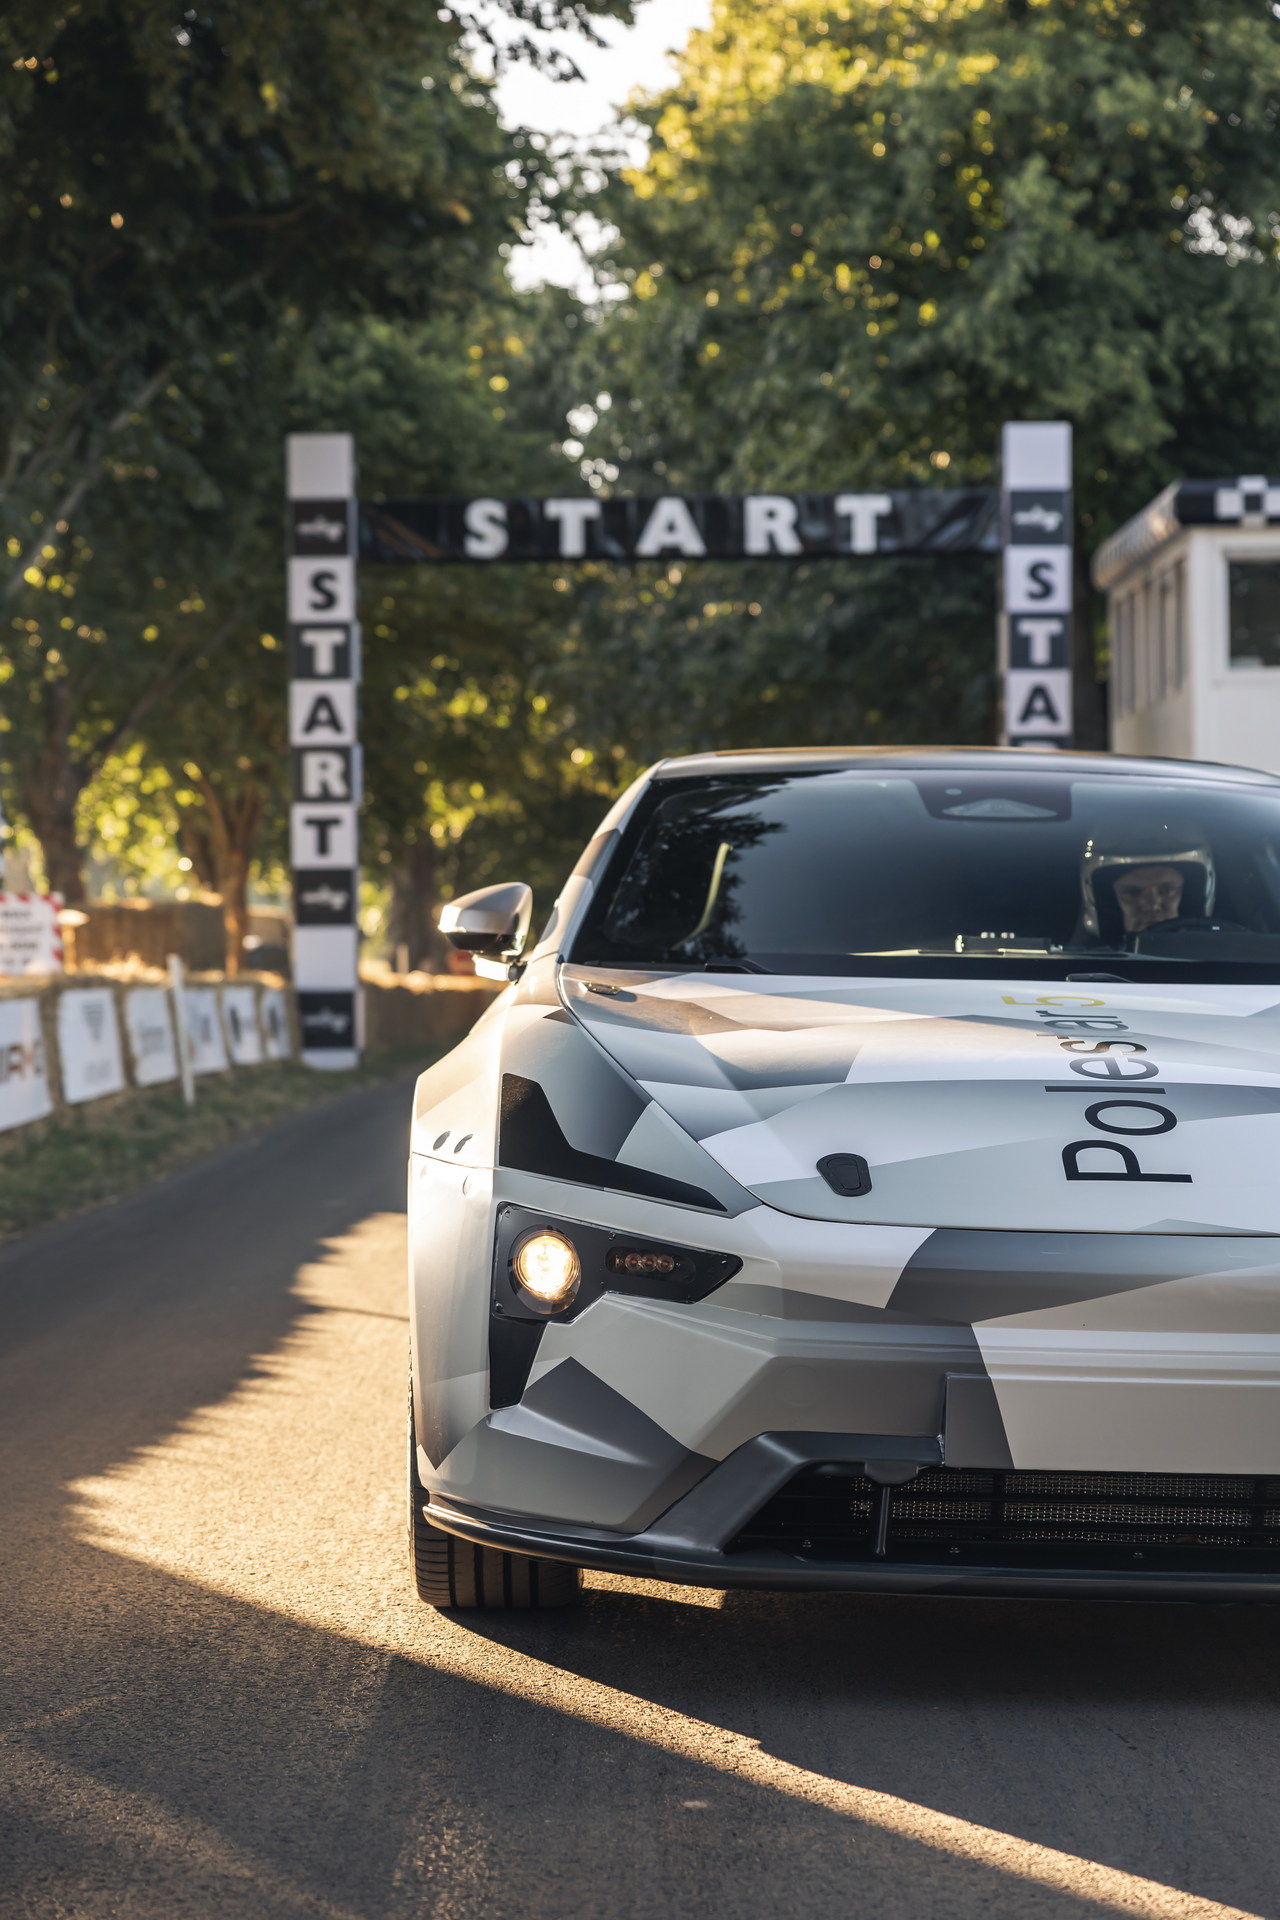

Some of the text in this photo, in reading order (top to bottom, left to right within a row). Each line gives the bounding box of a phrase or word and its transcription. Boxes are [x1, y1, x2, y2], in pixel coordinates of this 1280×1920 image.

[463, 494, 893, 559] START
[300, 570, 348, 857] START
[1016, 561, 1064, 749] STA
[1001, 995, 1193, 1183] Polestar 5
